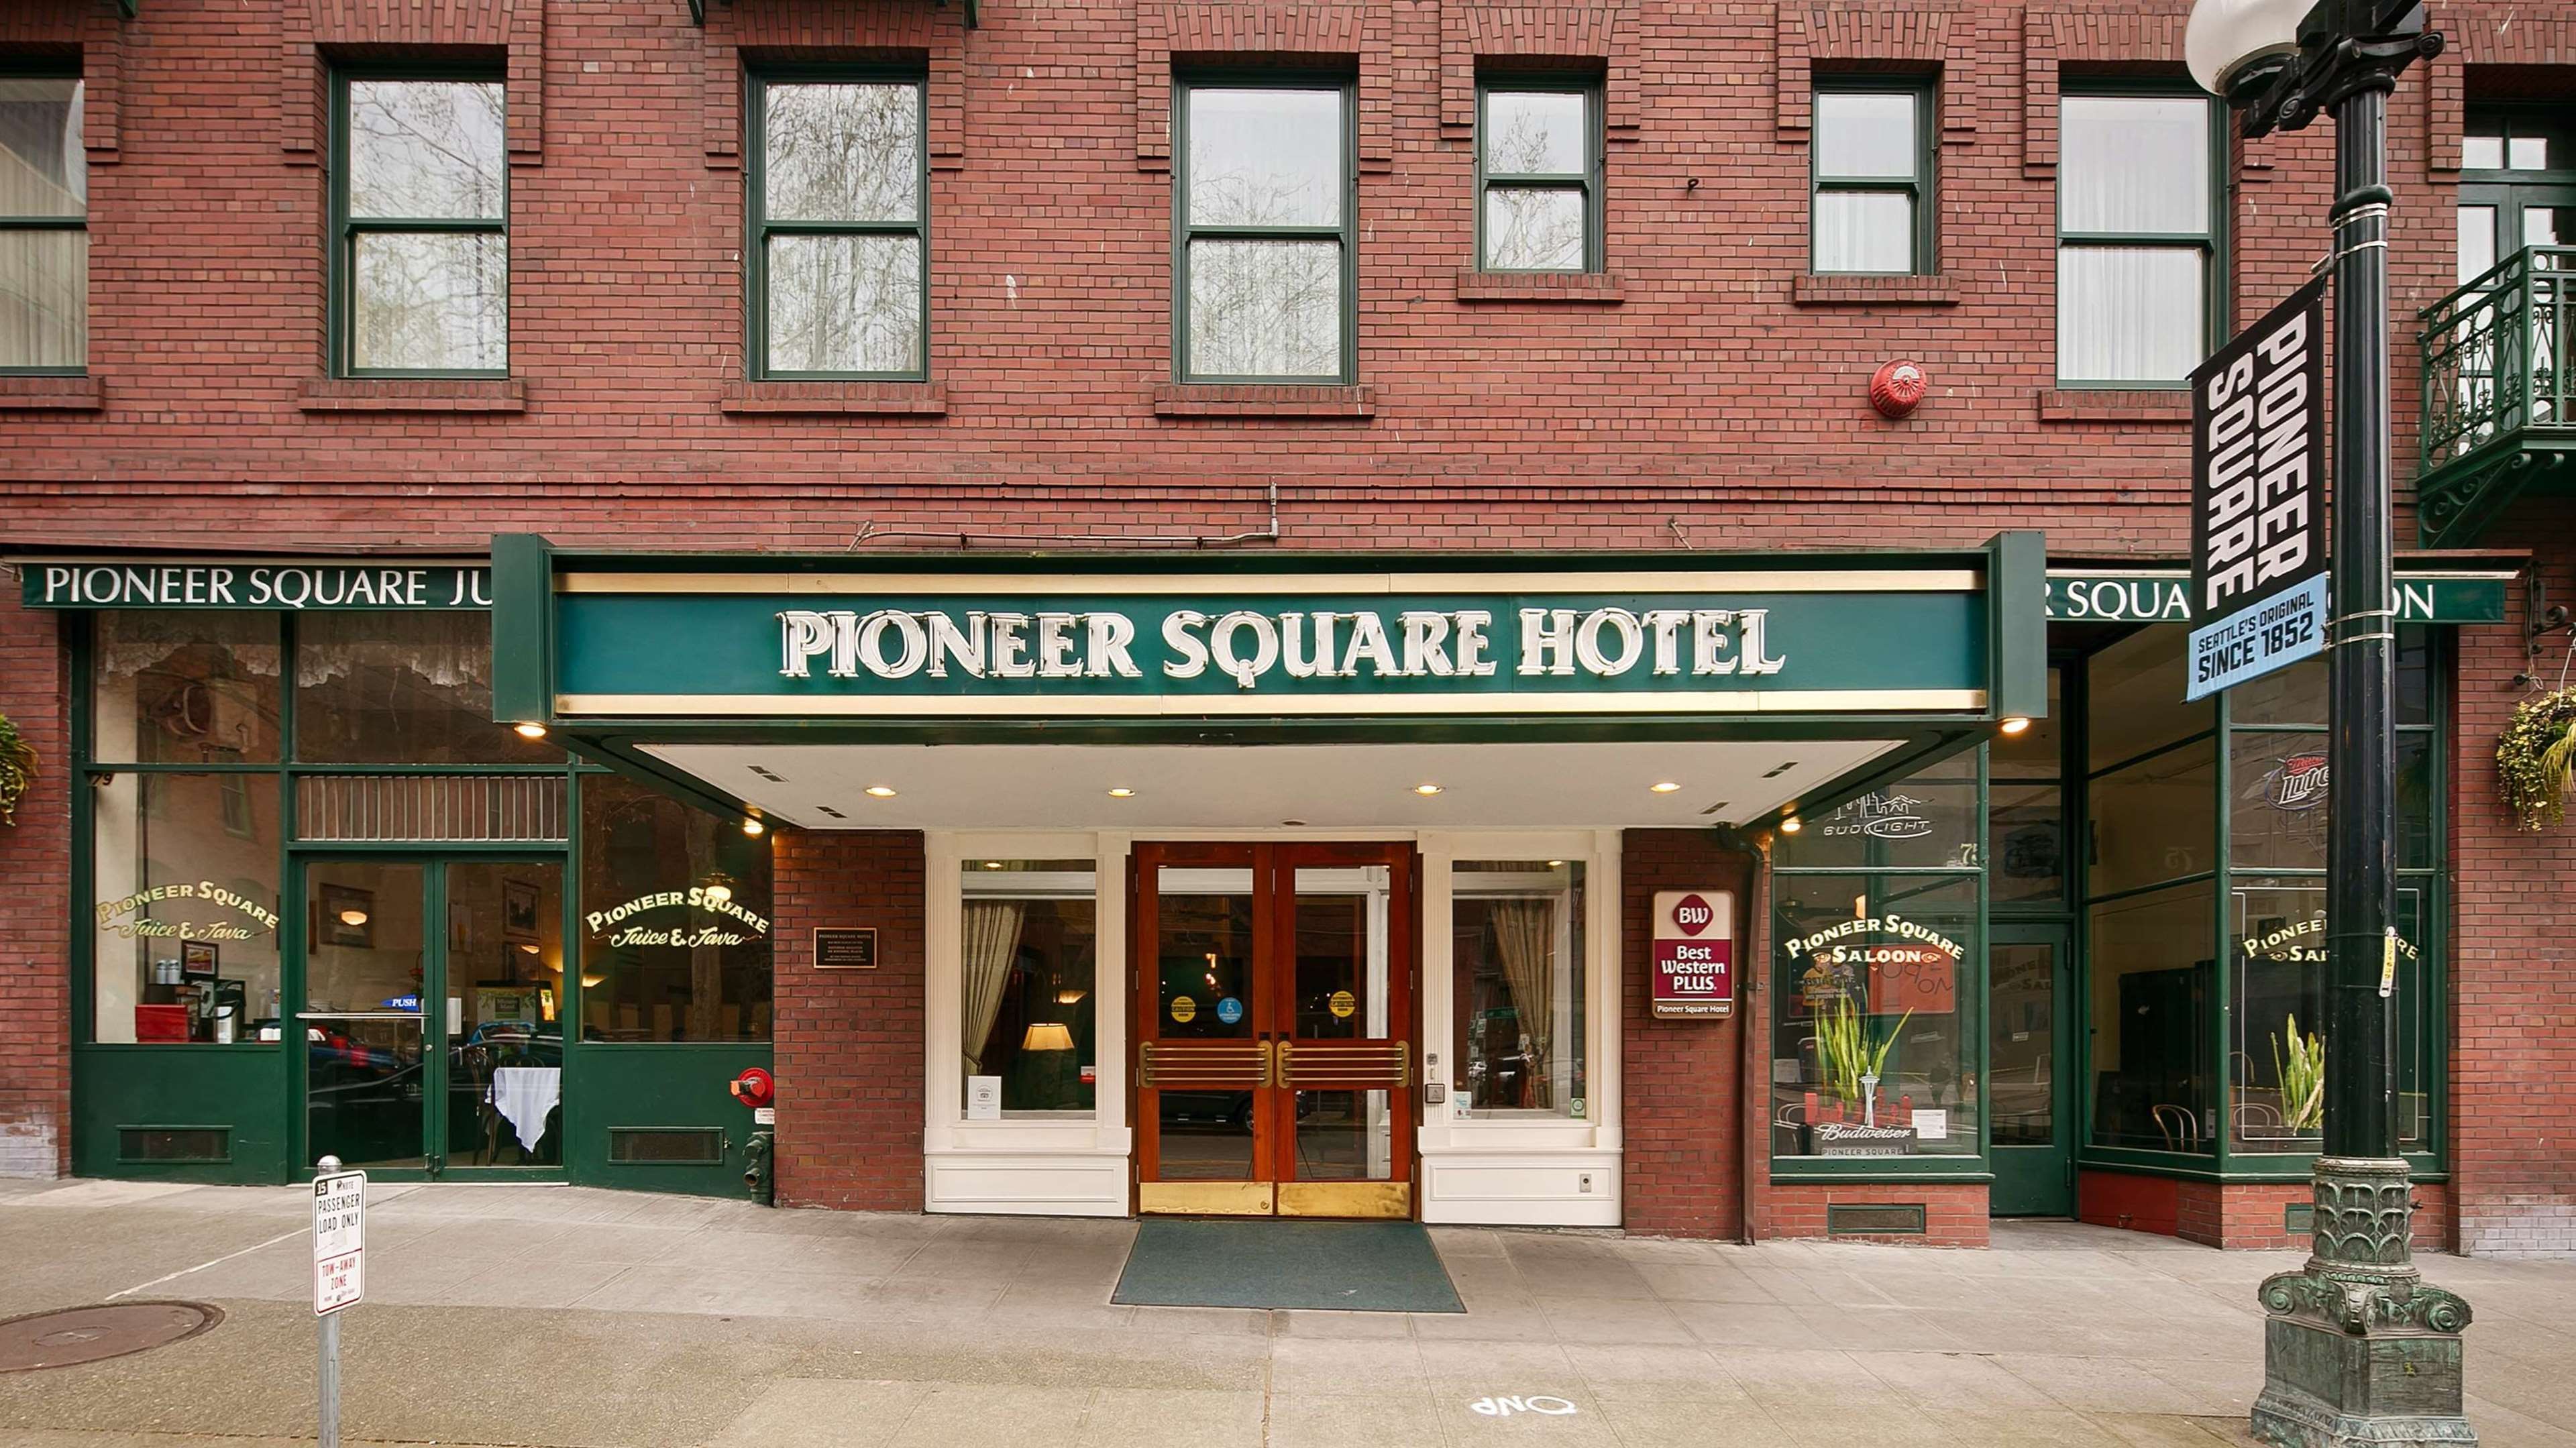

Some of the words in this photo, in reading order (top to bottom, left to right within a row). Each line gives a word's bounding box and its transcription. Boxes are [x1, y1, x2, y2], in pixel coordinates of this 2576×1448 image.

[2257, 311, 2308, 586] PIONEER
[2206, 351, 2254, 611] SQUARE
[45, 567, 236, 604] PIONEER
[248, 568, 428, 609] SQUARE
[2198, 615, 2255, 653] SEATTLE'S
[2259, 591, 2314, 627] ORIGINAL
[776, 608, 1143, 679] PIONEER
[1162, 608, 1498, 689] SQUARE
[1517, 606, 1786, 677] HOTEL
[2198, 636, 2255, 683] SINCE
[2260, 611, 2314, 658] 1852
[1873, 820, 1930, 832] LIGHT
[96, 884, 193, 924] PIONEER
[197, 880, 280, 930] SQUARE
[585, 891, 684, 934] PIONEER
[688, 887, 770, 934] SQUARE
[1679, 907, 1709, 924] BW
[118, 918, 177, 939] Juice
[179, 922, 195, 940] &
[199, 921, 254, 940] Java
[610, 926, 668, 948] Juice
[671, 928, 687, 947] &
[688, 926, 743, 948] Java
[1784, 918, 1880, 959] PIONEER
[1884, 914, 1964, 960] SQUARE
[2243, 918, 2327, 958] PIONEE
[1676, 946, 1711, 960] Best
[1832, 945, 1921, 963] SALOON
[1661, 960, 1725, 974] Western
[392, 998, 417, 1007] PUSH
[1685, 1005, 1708, 1013] Square
[1815, 1123, 1911, 1140] Budweiser
[317, 1181, 327, 1194] 15
[318, 1193, 360, 1215] PASSENGER
[319, 1217, 337, 1234] LOAD
[341, 1212, 359, 1229] ONLY
[322, 1256, 356, 1278] TOW-AWAY
[331, 1274, 347, 1290] ZONE
